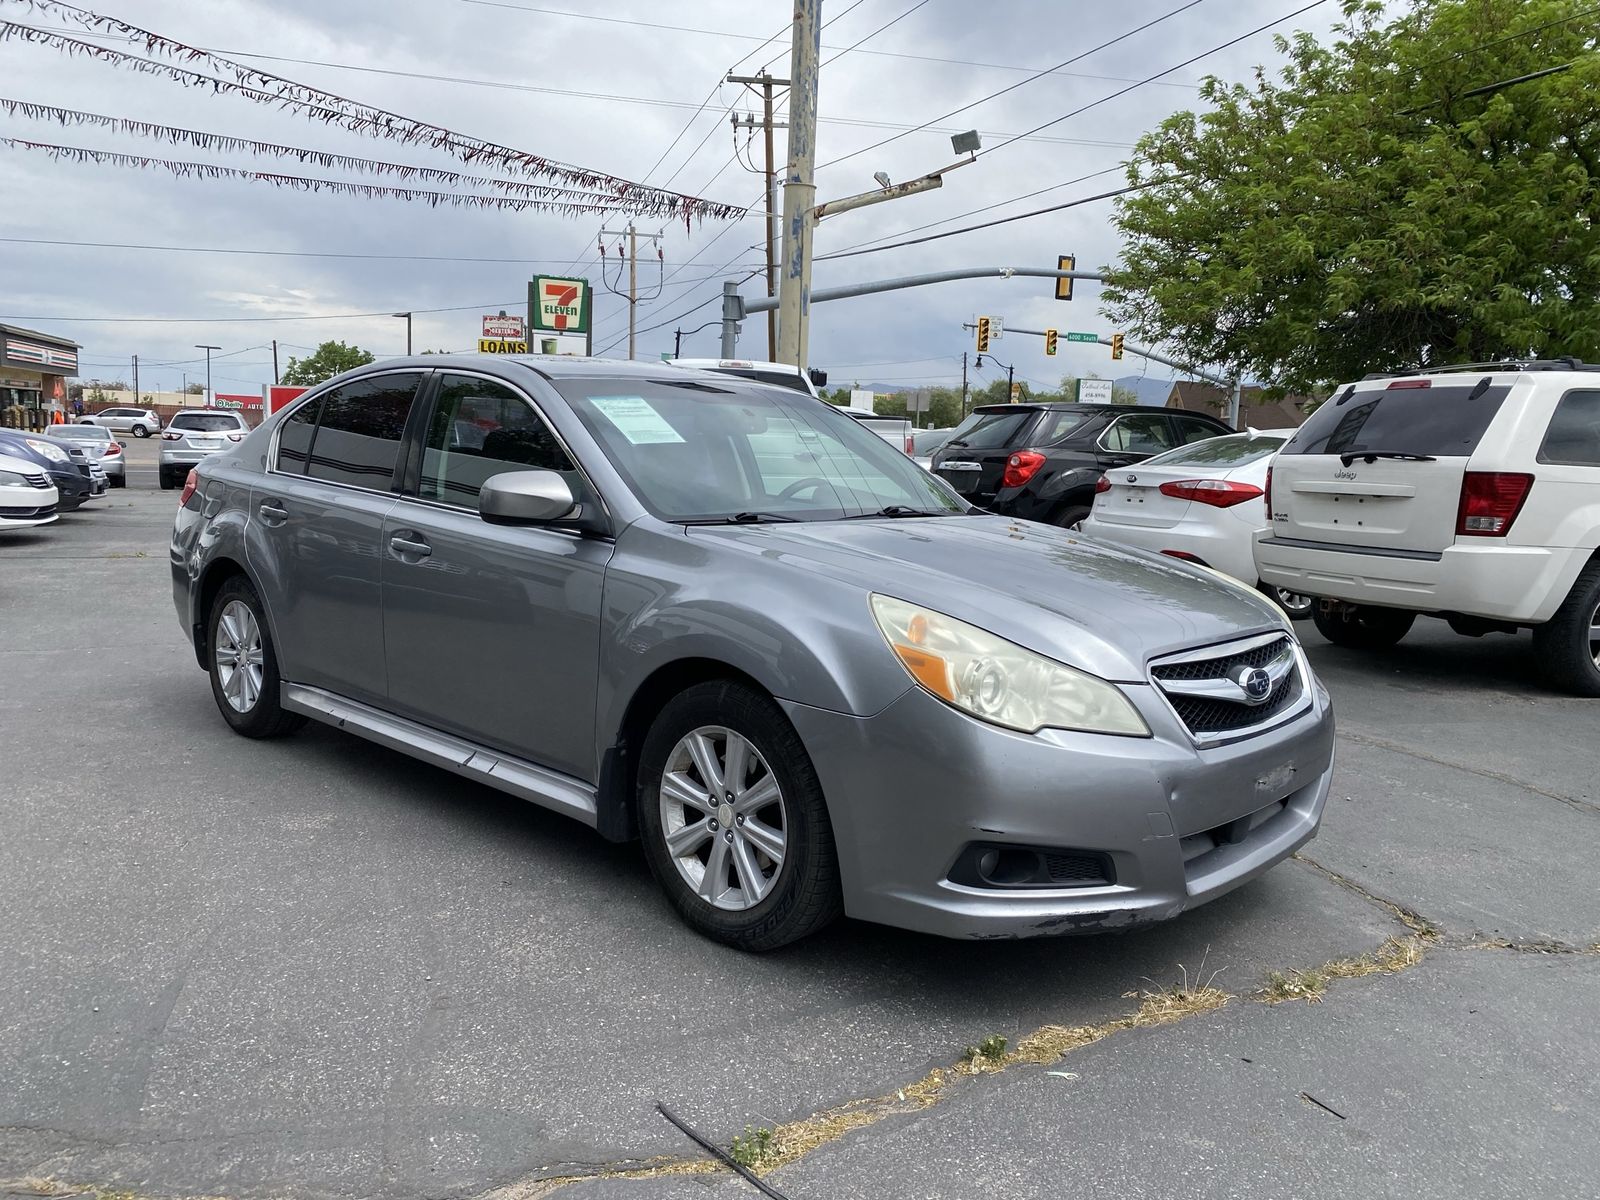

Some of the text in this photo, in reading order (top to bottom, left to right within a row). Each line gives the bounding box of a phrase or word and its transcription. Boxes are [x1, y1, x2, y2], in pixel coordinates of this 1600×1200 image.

[545, 284, 577, 329] 7
[480, 341, 526, 354] LOANS
[1334, 469, 1357, 480] Jeep
